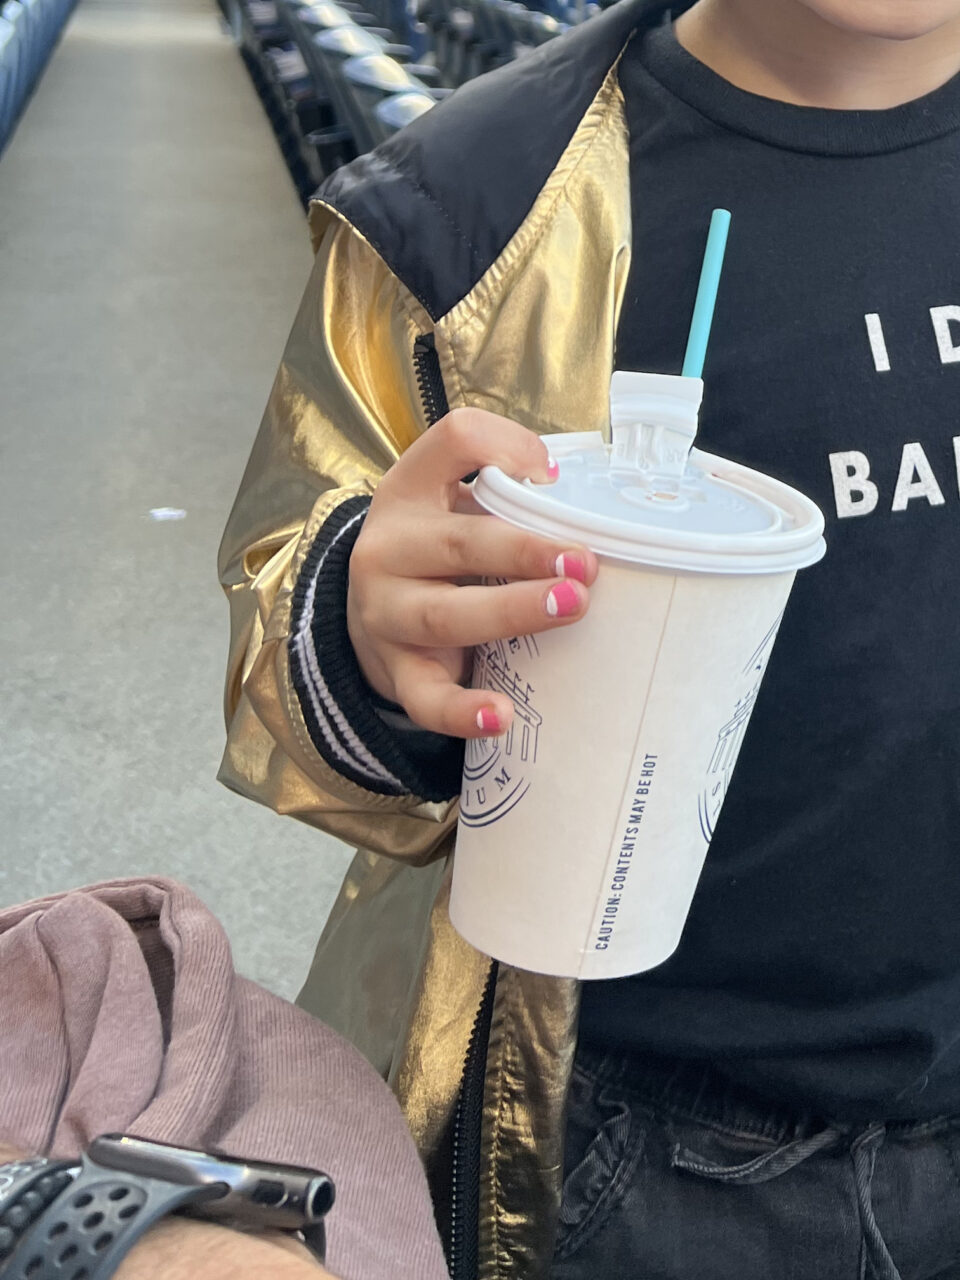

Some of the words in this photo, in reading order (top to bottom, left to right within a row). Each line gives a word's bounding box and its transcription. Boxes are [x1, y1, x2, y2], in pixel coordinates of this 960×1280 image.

[864, 313, 891, 372] I
[641, 753, 658, 777] HOT
[636, 779, 652, 795] BE
[628, 798, 646, 824] MAY
[611, 827, 639, 891] CONTENTS
[595, 892, 622, 951] CAUTION:
